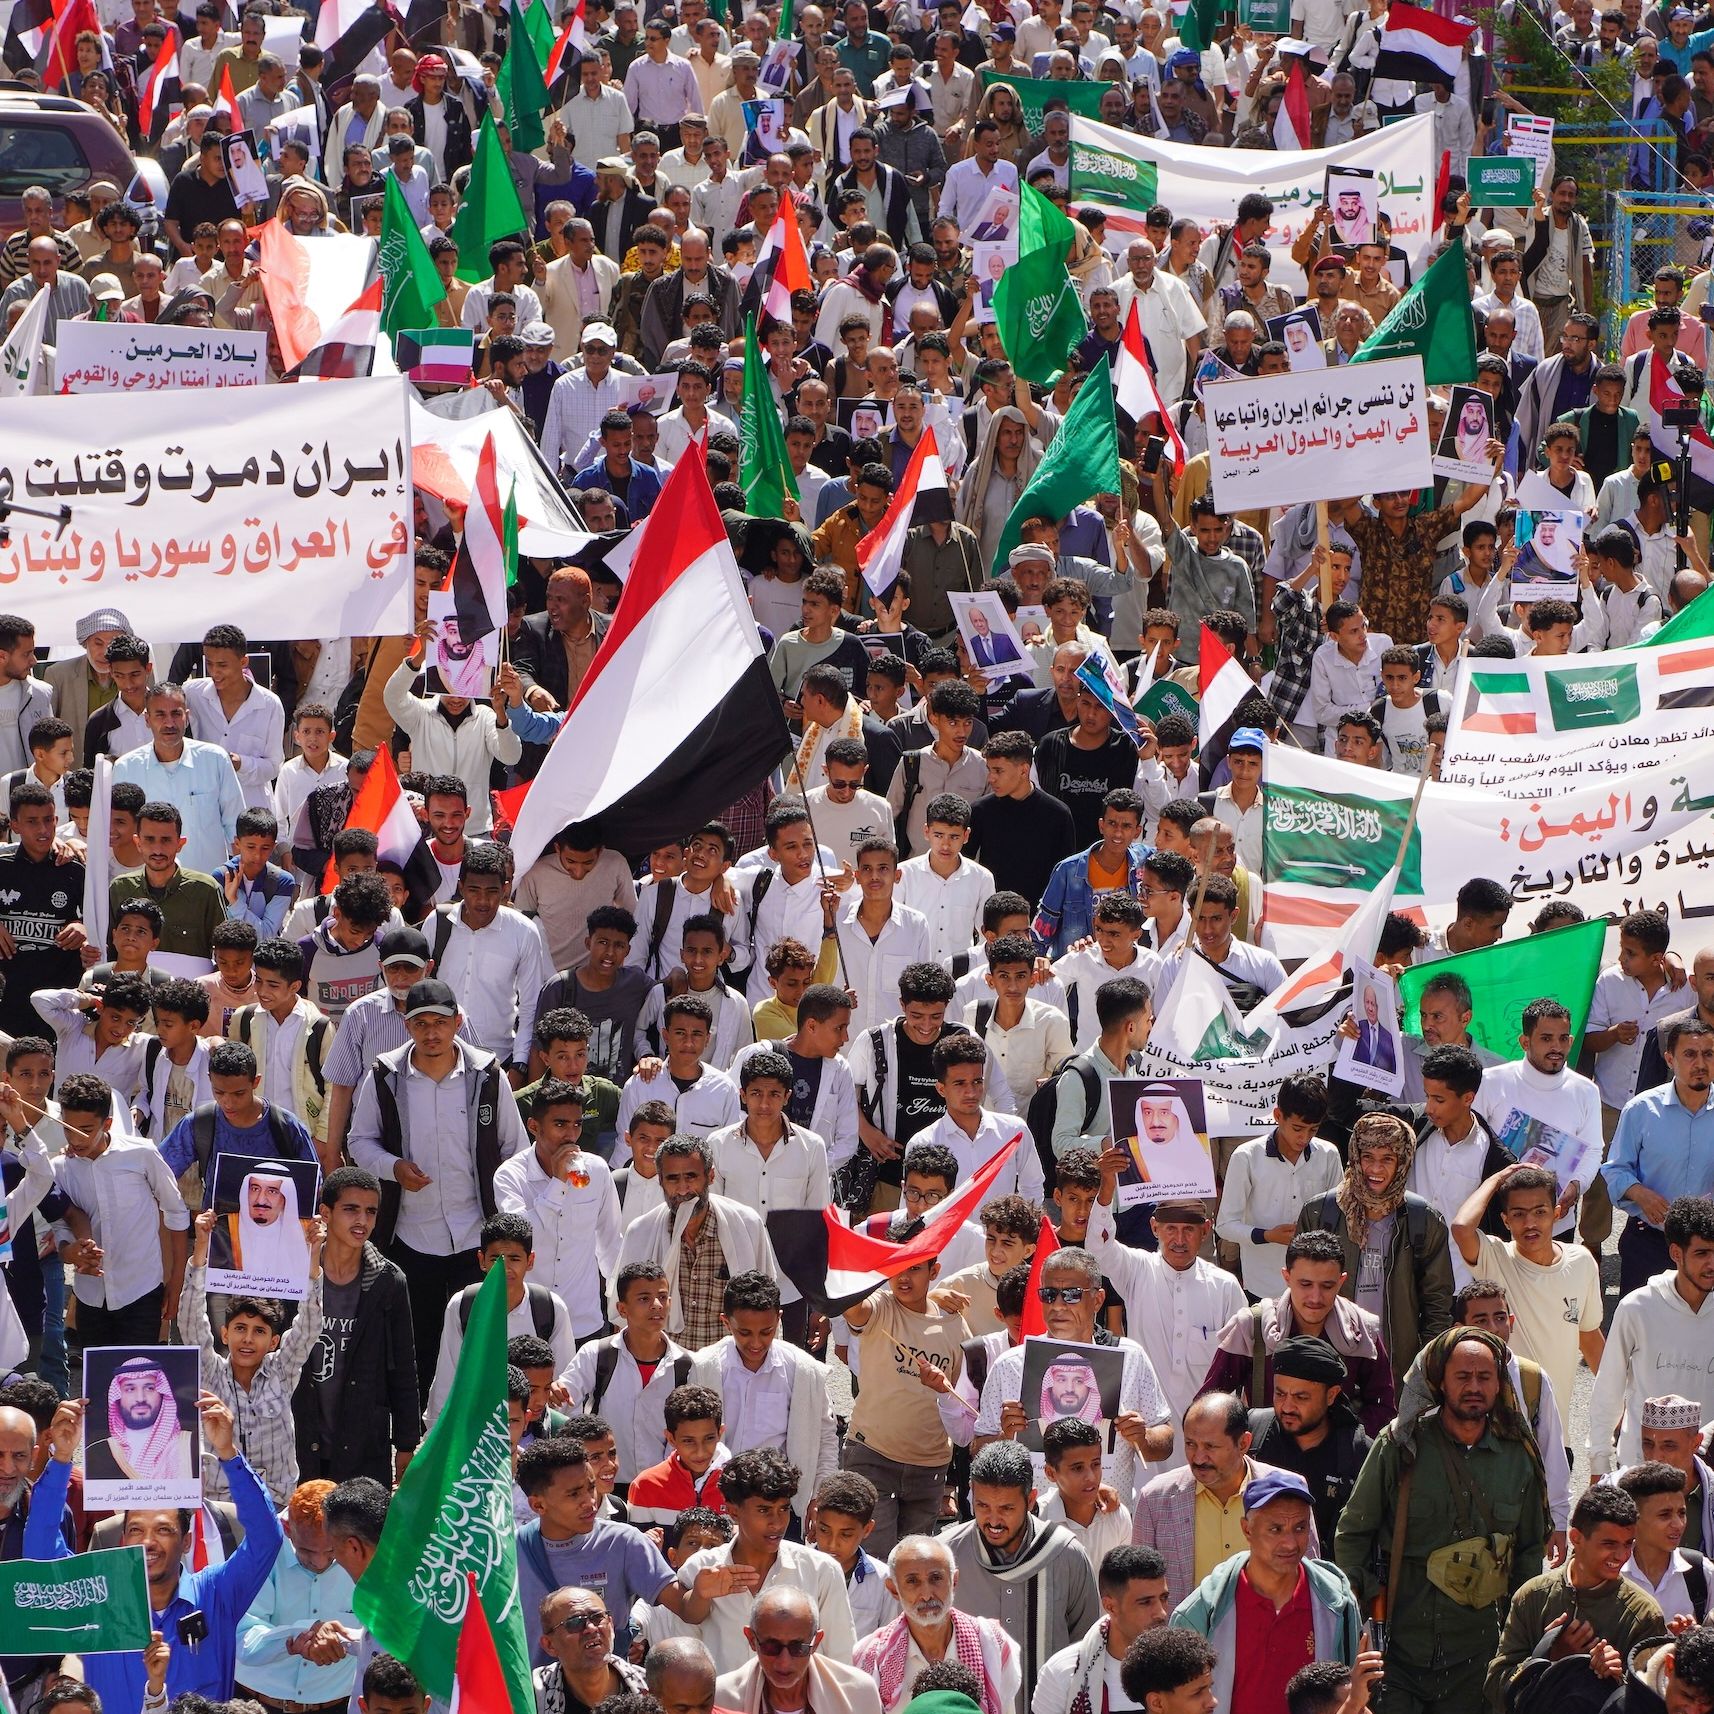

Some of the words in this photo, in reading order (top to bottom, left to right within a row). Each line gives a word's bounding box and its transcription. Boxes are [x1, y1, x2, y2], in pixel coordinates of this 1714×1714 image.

[214, 342, 258, 368] بلاد
[123, 366, 175, 392] الروحي
[1312, 392, 1353, 421] جرائم
[1358, 385, 1394, 415] ننسى
[1398, 382, 1415, 409] لن
[1214, 398, 1269, 432] وأتباعها
[1271, 397, 1309, 426] إيران
[1287, 425, 1341, 457] والدول
[1345, 418, 1391, 449] اليمن
[1395, 412, 1418, 444] في
[1220, 432, 1284, 462] العربية
[25, 448, 151, 507] وقتلت
[157, 445, 286, 503] دمرت
[292, 437, 406, 498] إيران
[1222, 469, 1241, 479] اليمن
[115, 527, 237, 582] وسوريا
[243, 516, 351, 574] العراق
[365, 511, 408, 580] في
[1608, 735, 1650, 749] معادن
[1653, 731, 1688, 748] تظهر
[1449, 752, 1495, 766] اليمني
[1499, 752, 1551, 765] والشعب
[1548, 762, 1582, 777] اليوم
[1587, 758, 1628, 775] ويؤكد
[1480, 771, 1505, 788] قلباً
[1509, 851, 1643, 903] والتاريخ
[1207, 1092, 1269, 1110] الأساسية
